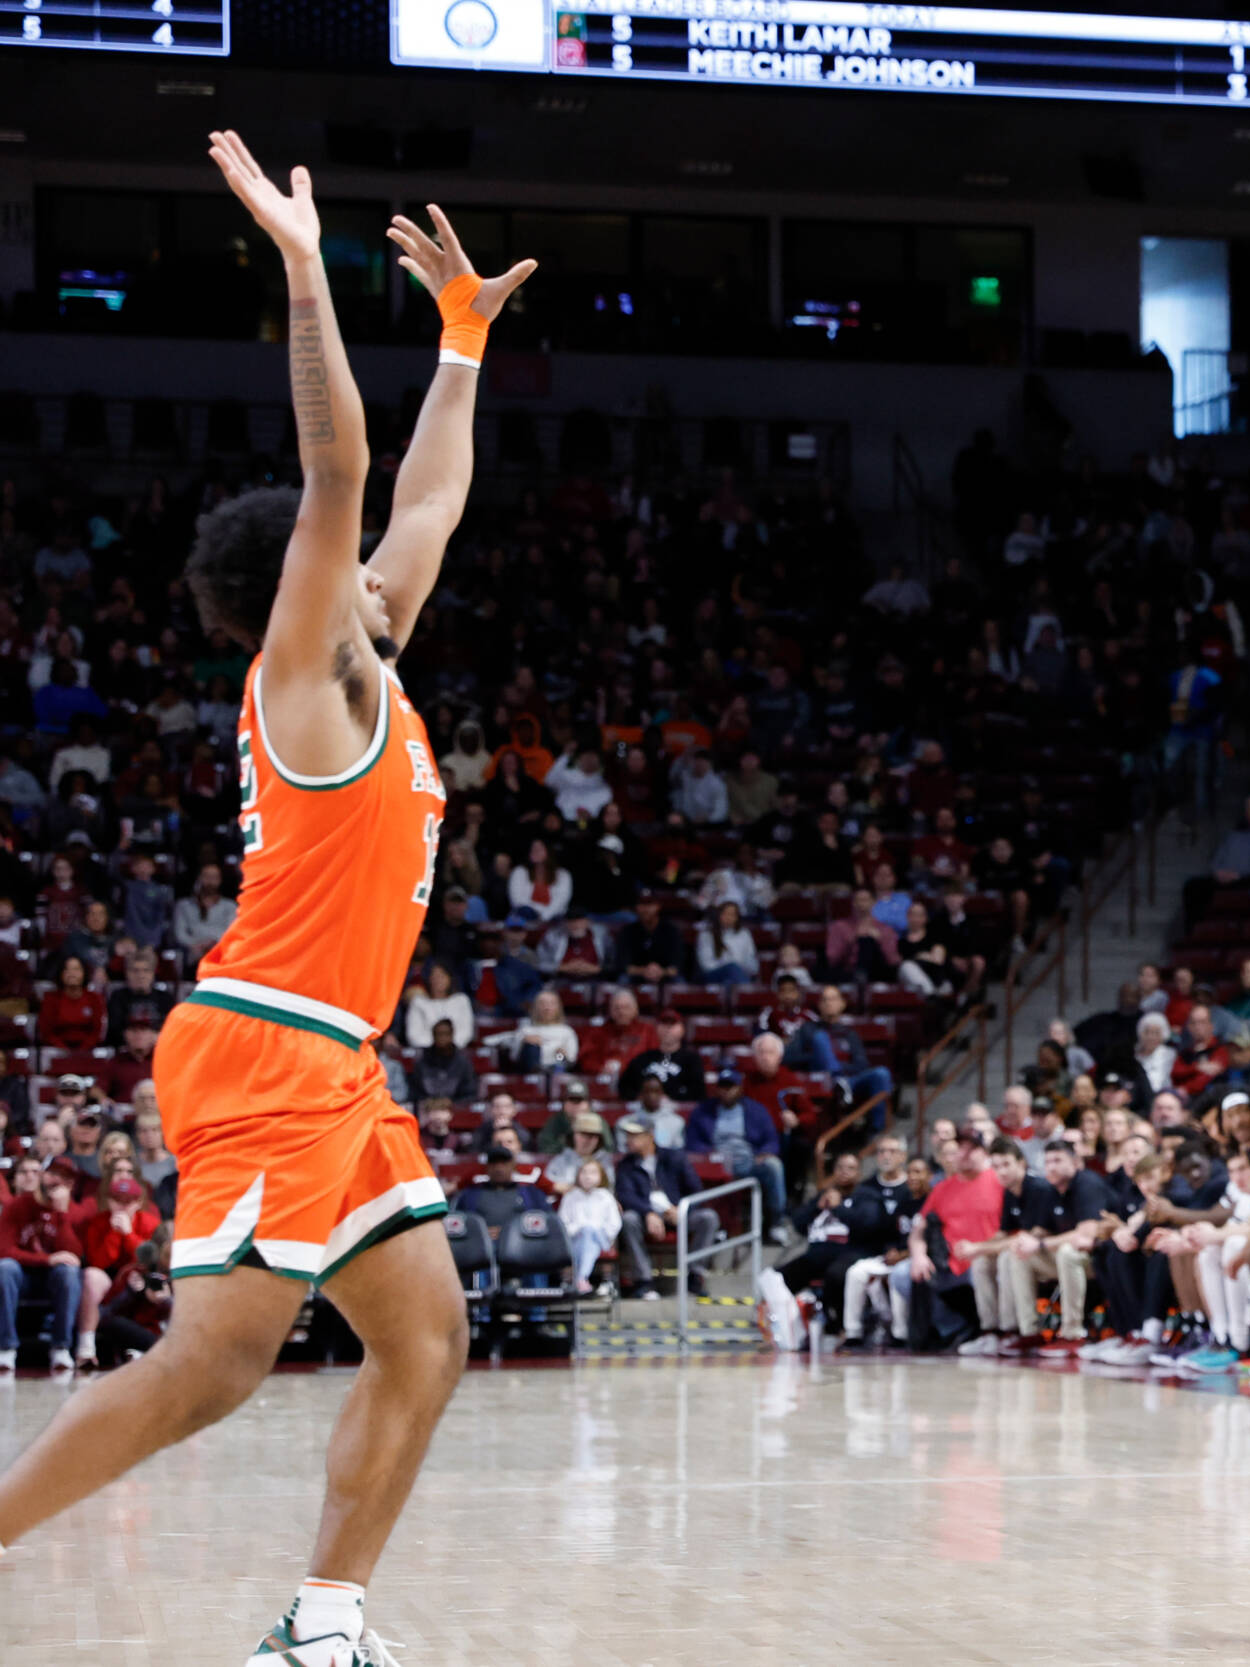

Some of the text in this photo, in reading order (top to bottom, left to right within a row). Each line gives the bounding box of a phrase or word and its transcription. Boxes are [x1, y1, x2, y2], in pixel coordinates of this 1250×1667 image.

[688, 18, 778, 49] KEITH
[783, 24, 892, 55] LAMAR
[688, 48, 823, 82] MEECHIE
[826, 55, 975, 88] JOHNSON
